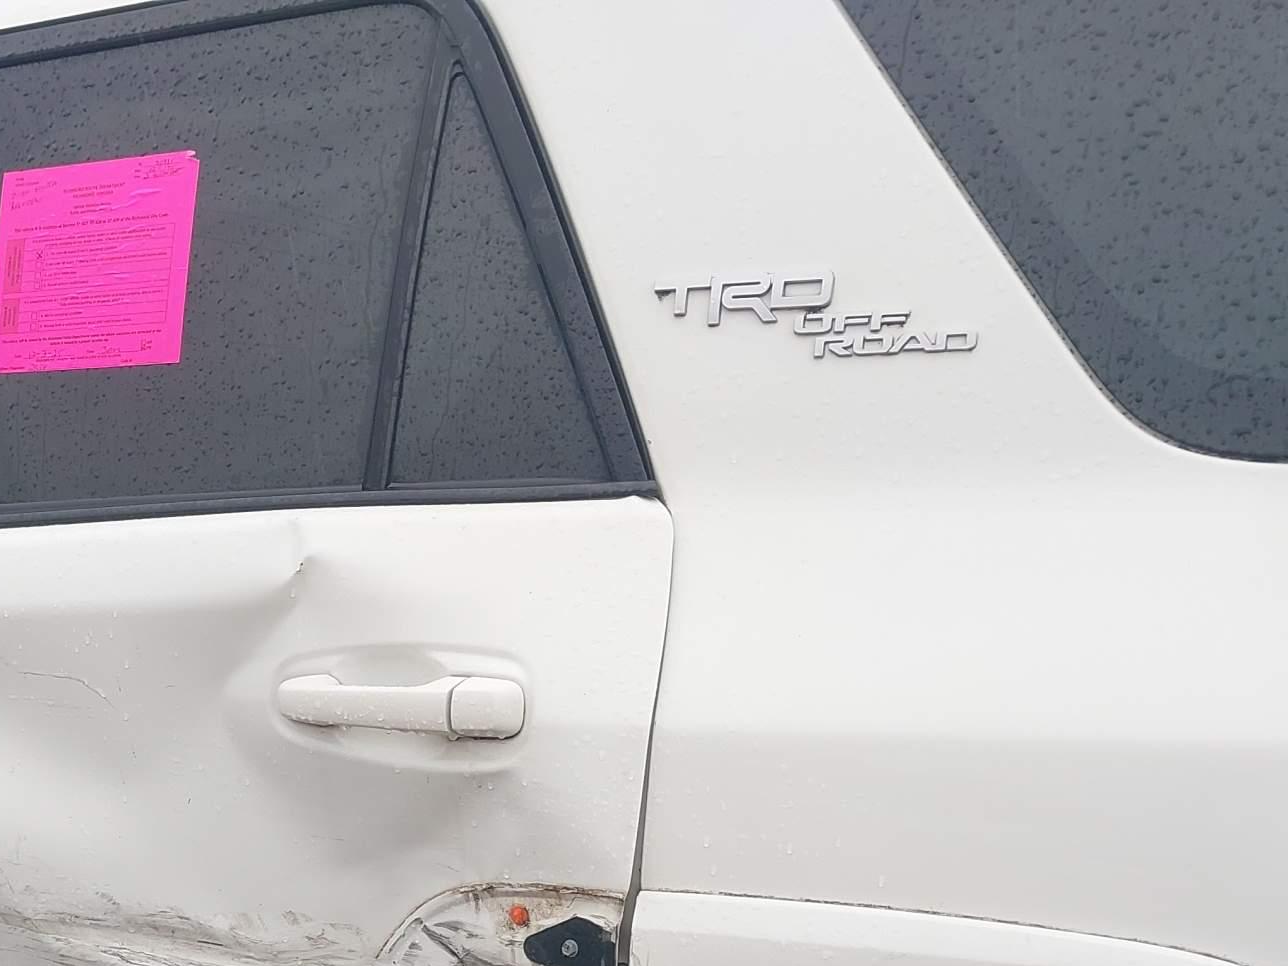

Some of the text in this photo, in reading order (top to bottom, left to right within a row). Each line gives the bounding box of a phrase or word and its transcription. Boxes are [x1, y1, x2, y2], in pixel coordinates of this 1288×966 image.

[654, 271, 835, 326] TRD
[793, 310, 911, 334] OFF
[814, 331, 979, 358] ROAD
